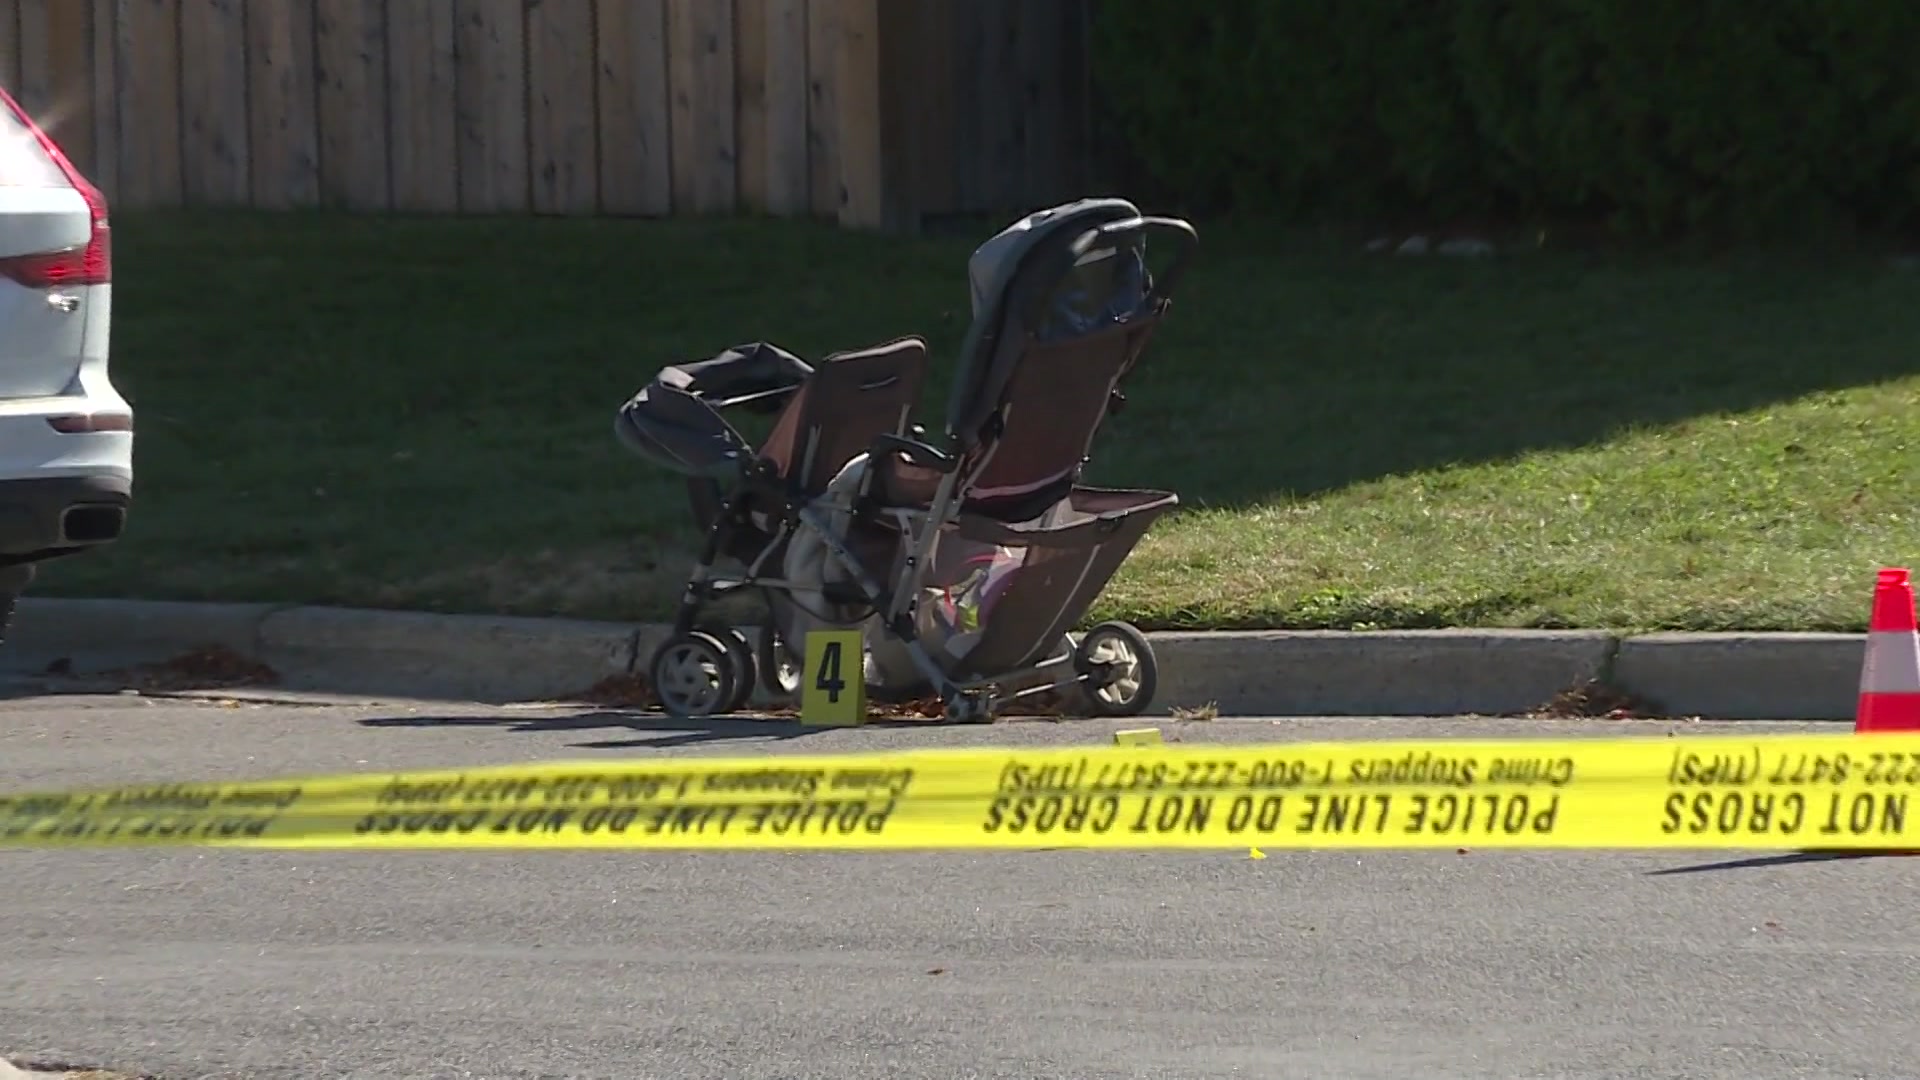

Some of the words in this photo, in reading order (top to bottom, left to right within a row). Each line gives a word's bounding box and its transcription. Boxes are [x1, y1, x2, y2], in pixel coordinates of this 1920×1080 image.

[816, 642, 845, 703] 4
[1090, 759, 1334, 791] 1-800-222-8477
[1348, 751, 1480, 788] Stoppers
[1487, 757, 1575, 788] Crime
[1667, 746, 1761, 786] (TIPS)
[491, 806, 577, 834] NOT
[581, 805, 640, 834] DO
[644, 803, 738, 835] LINE
[745, 798, 897, 835] POLICE
[983, 795, 1121, 834] CROSS
[1128, 796, 1213, 834] NOT
[1226, 795, 1284, 834] DO
[1296, 795, 1392, 834] LINE
[1403, 795, 1560, 834] POLICE
[1661, 791, 1806, 835] CROSS
[1819, 792, 1908, 835] NOT
